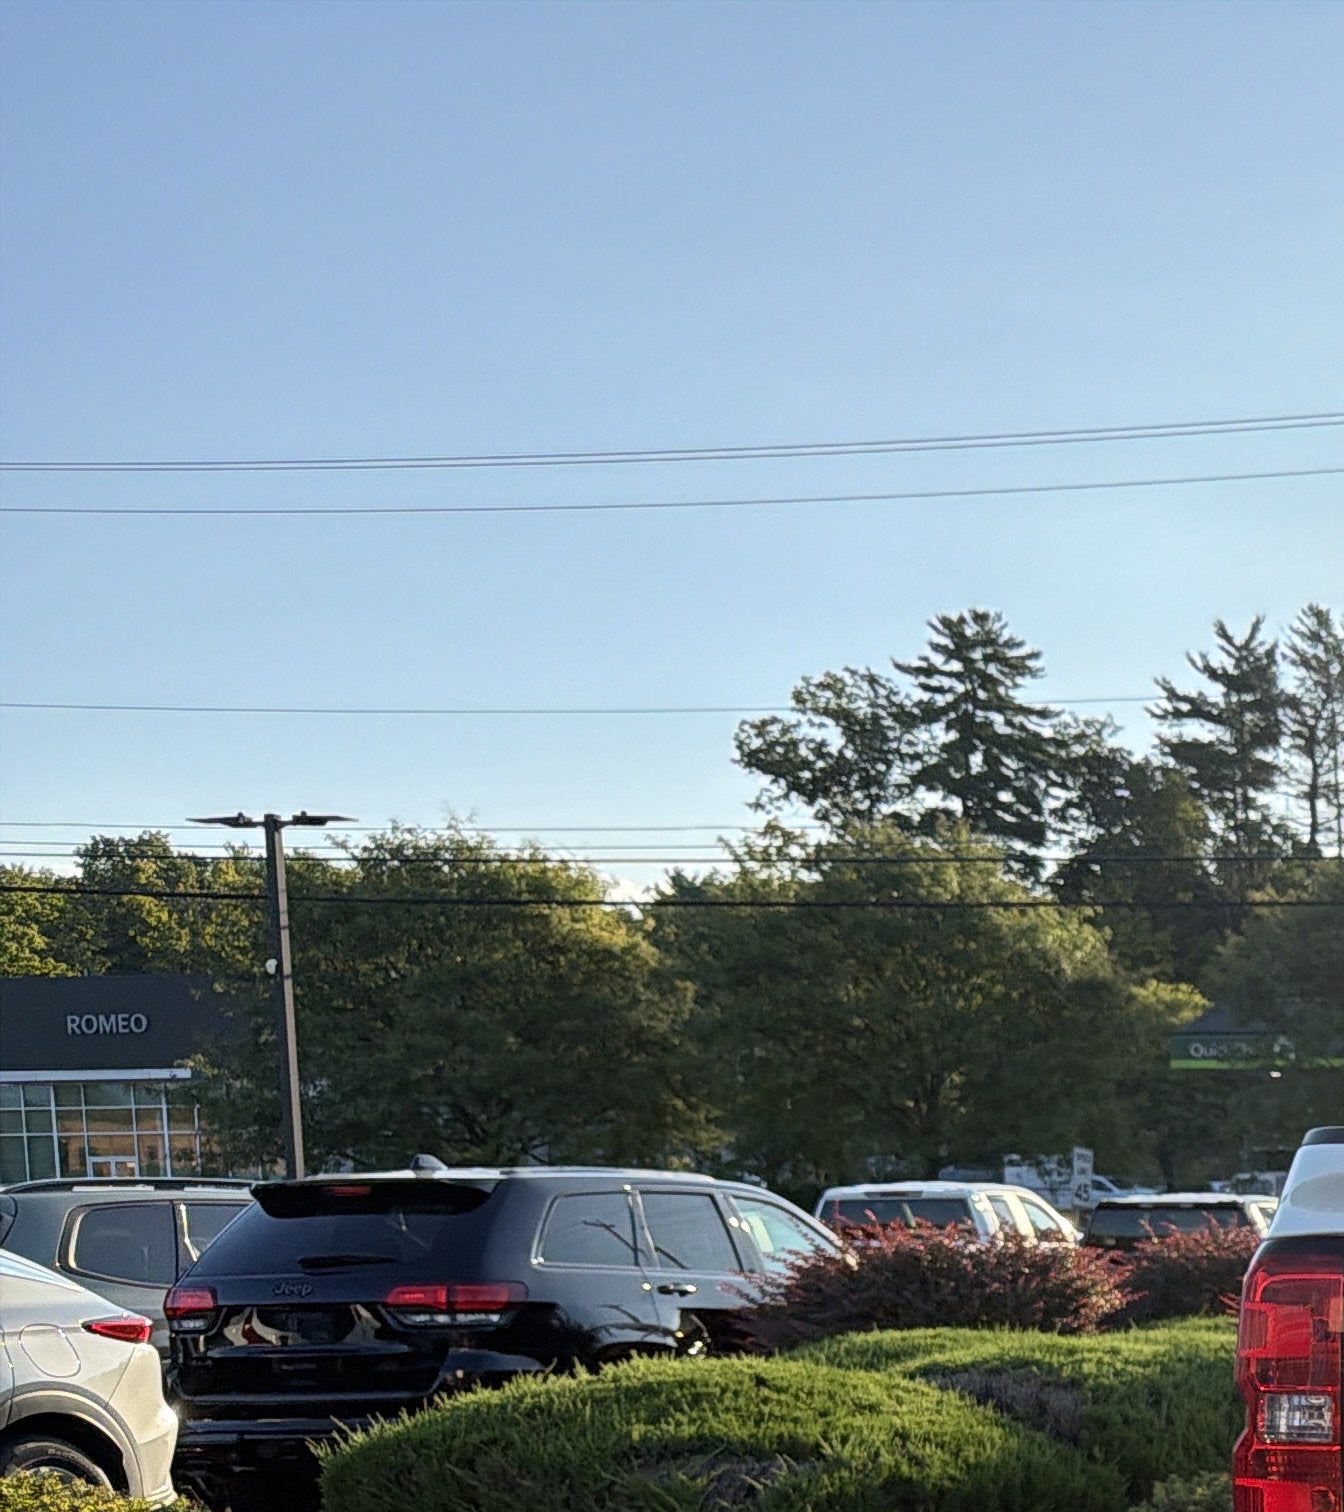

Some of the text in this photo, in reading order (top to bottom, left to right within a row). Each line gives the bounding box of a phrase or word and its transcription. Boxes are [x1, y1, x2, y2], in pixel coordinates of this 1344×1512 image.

[66, 1012, 148, 1035] ROMEO
[1075, 1183, 1090, 1202] 45
[273, 1281, 313, 1297] Jeep
